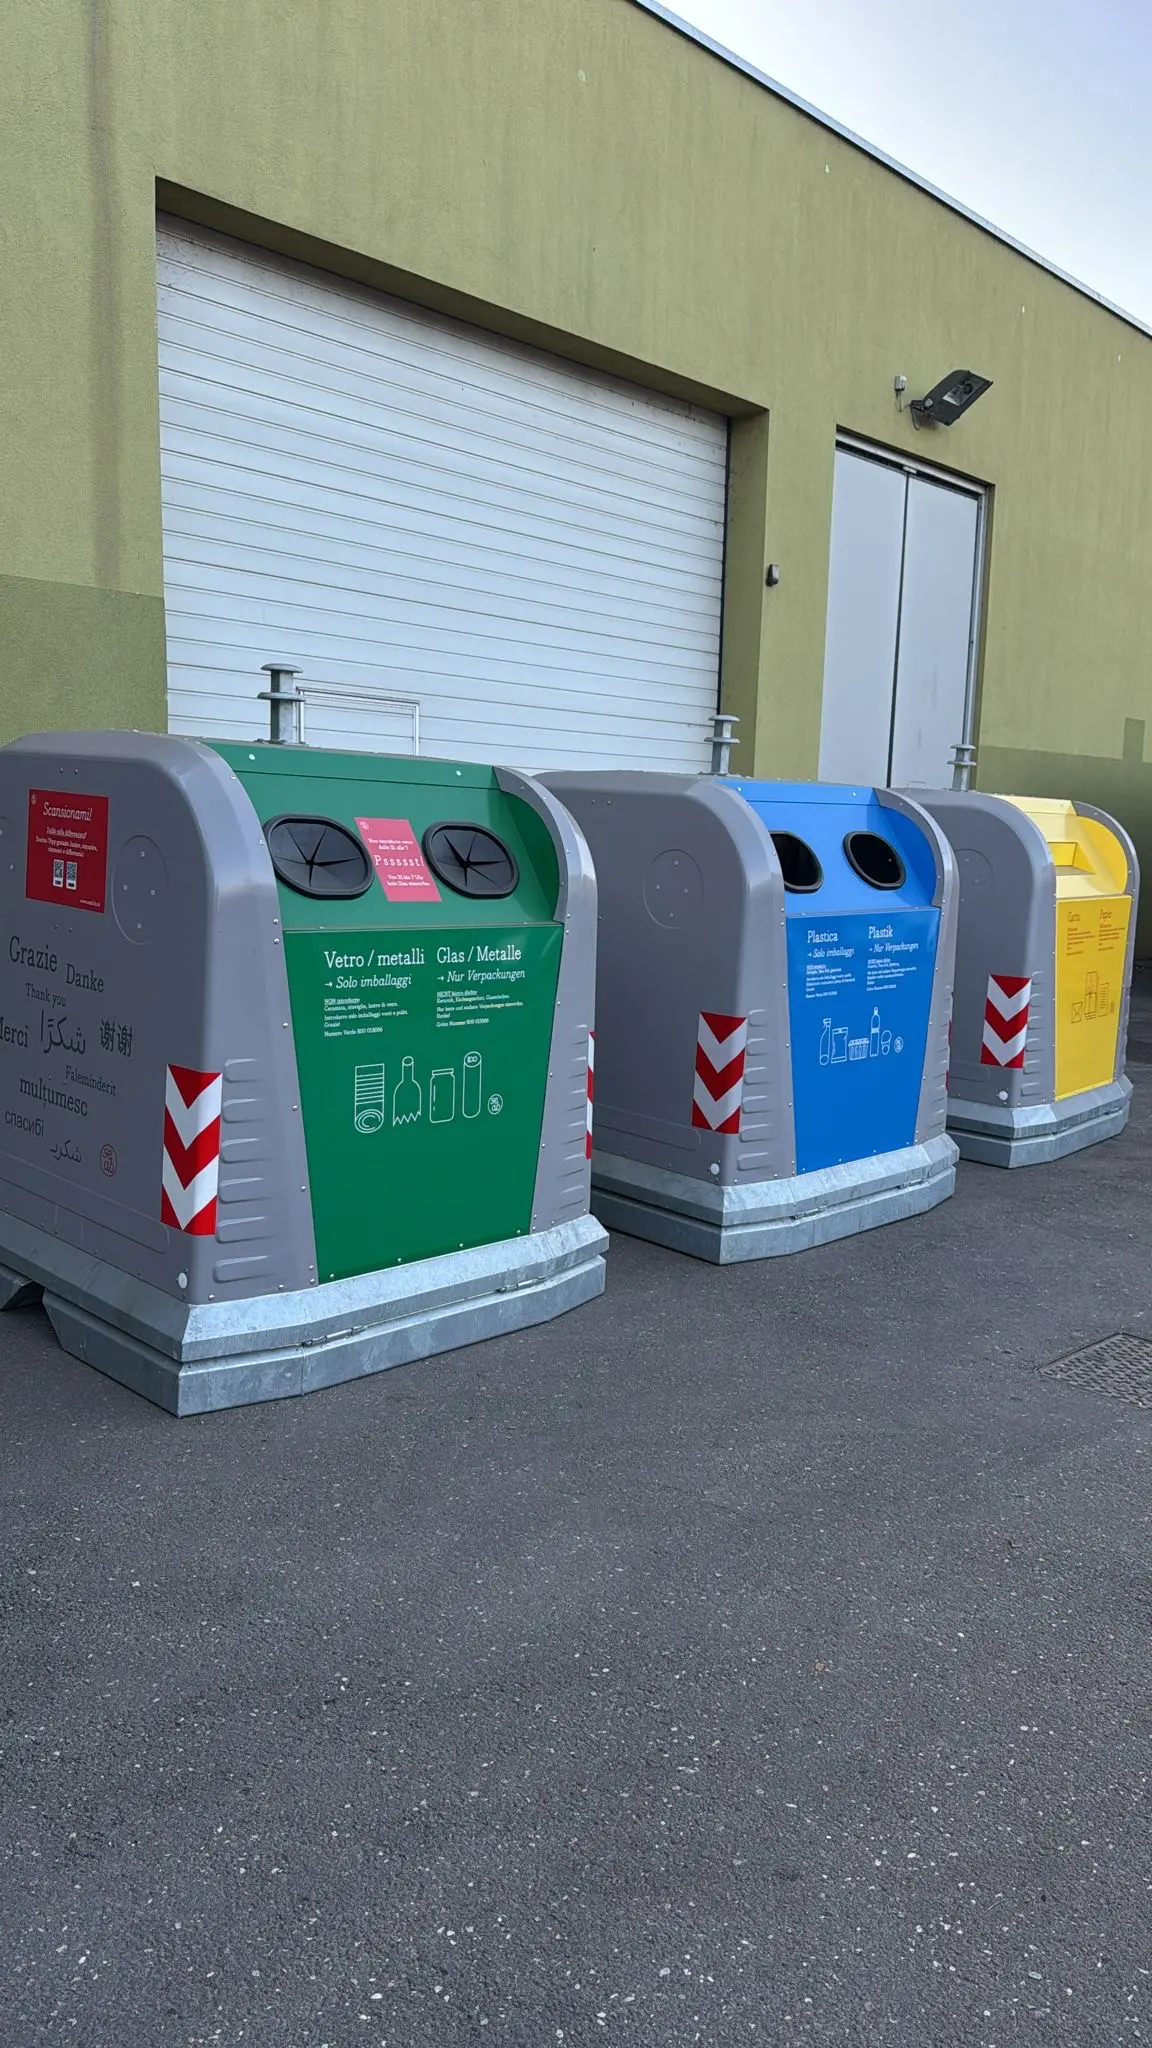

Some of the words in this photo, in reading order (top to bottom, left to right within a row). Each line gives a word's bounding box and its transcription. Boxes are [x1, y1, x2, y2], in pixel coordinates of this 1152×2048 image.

[43, 802, 93, 821] Scansionami!
[807, 929, 838, 943] Plastica
[868, 924, 893, 939] Plastik
[9, 935, 57, 972] Grazie
[437, 947, 465, 964] Glas
[467, 946, 474, 962] /
[476, 945, 521, 962] Metalle
[812, 948, 825, 958] Solo
[826, 946, 855, 958] imballaggi
[873, 944, 884, 953] Nur
[885, 942, 919, 954] Verpackungen
[323, 951, 365, 968] Vetro
[367, 949, 375, 967] /
[377, 948, 425, 966] metalli
[65, 963, 104, 993] Danke
[336, 975, 358, 989] Solo
[360, 973, 412, 989] imballaggi
[447, 970, 465, 982] Nur
[468, 968, 525, 984] Verpackungen
[25, 982, 50, 1003] Thank
[52, 993, 67, 1008] you
[0, 1016, 28, 1048] erci
[100, 1019, 133, 1058] 谢谢
[65, 1065, 116, 1097] Faleminderit
